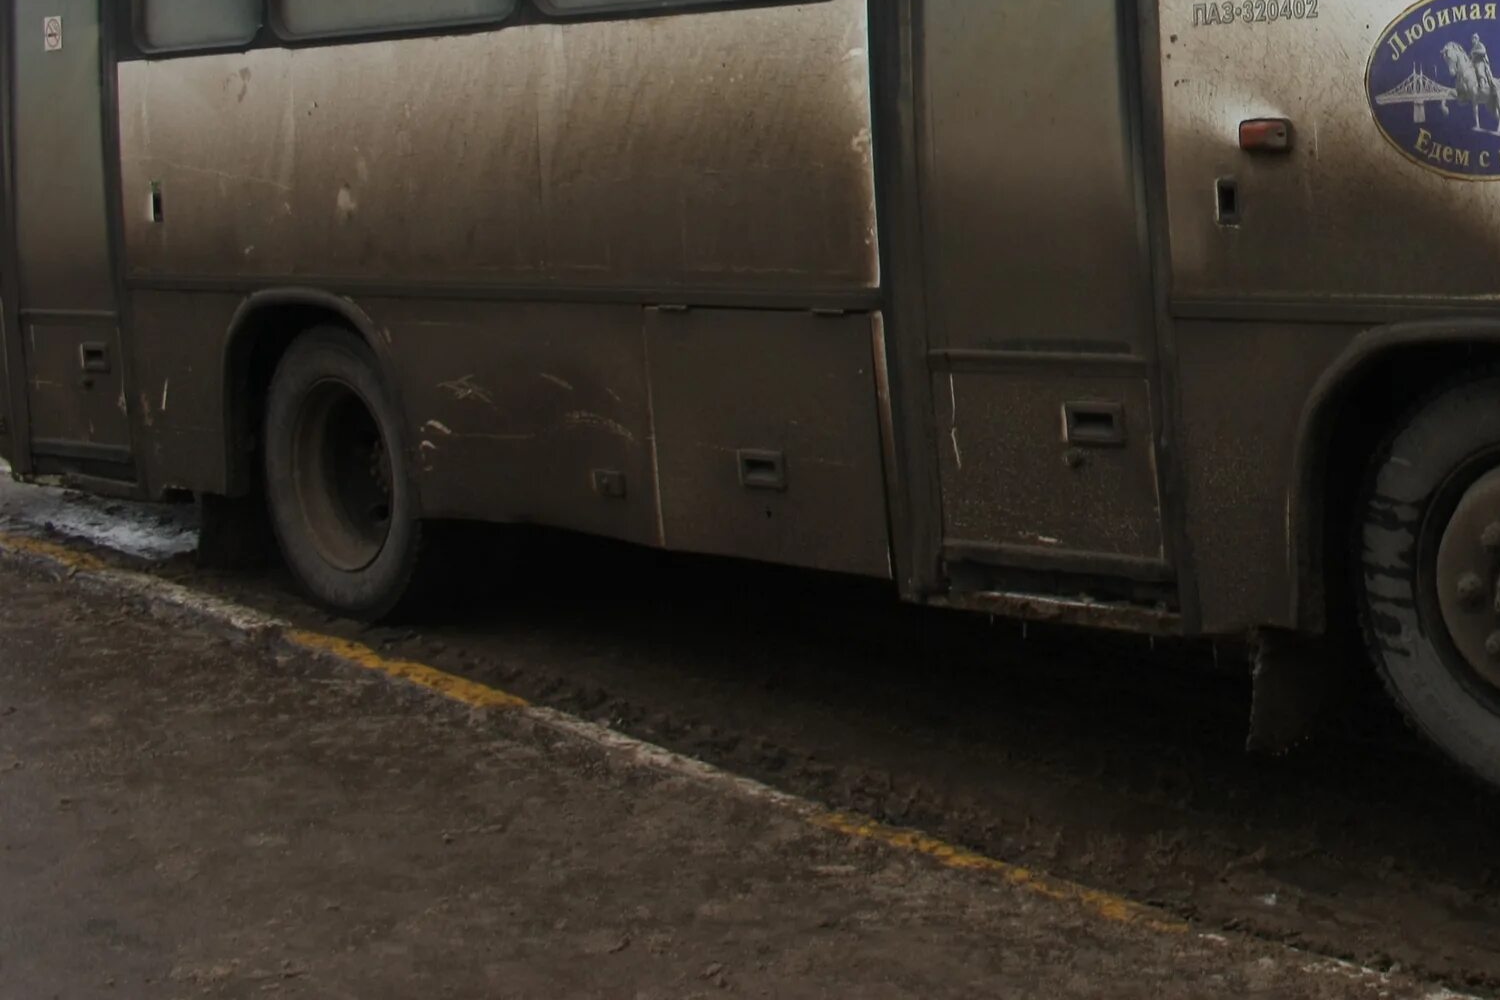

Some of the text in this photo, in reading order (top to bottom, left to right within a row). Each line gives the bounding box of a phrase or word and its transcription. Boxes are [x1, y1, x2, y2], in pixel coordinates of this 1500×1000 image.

[1387, 3, 1497, 61] Любимая
[1414, 128, 1470, 167] Едем
[1479, 150, 1490, 167] с
